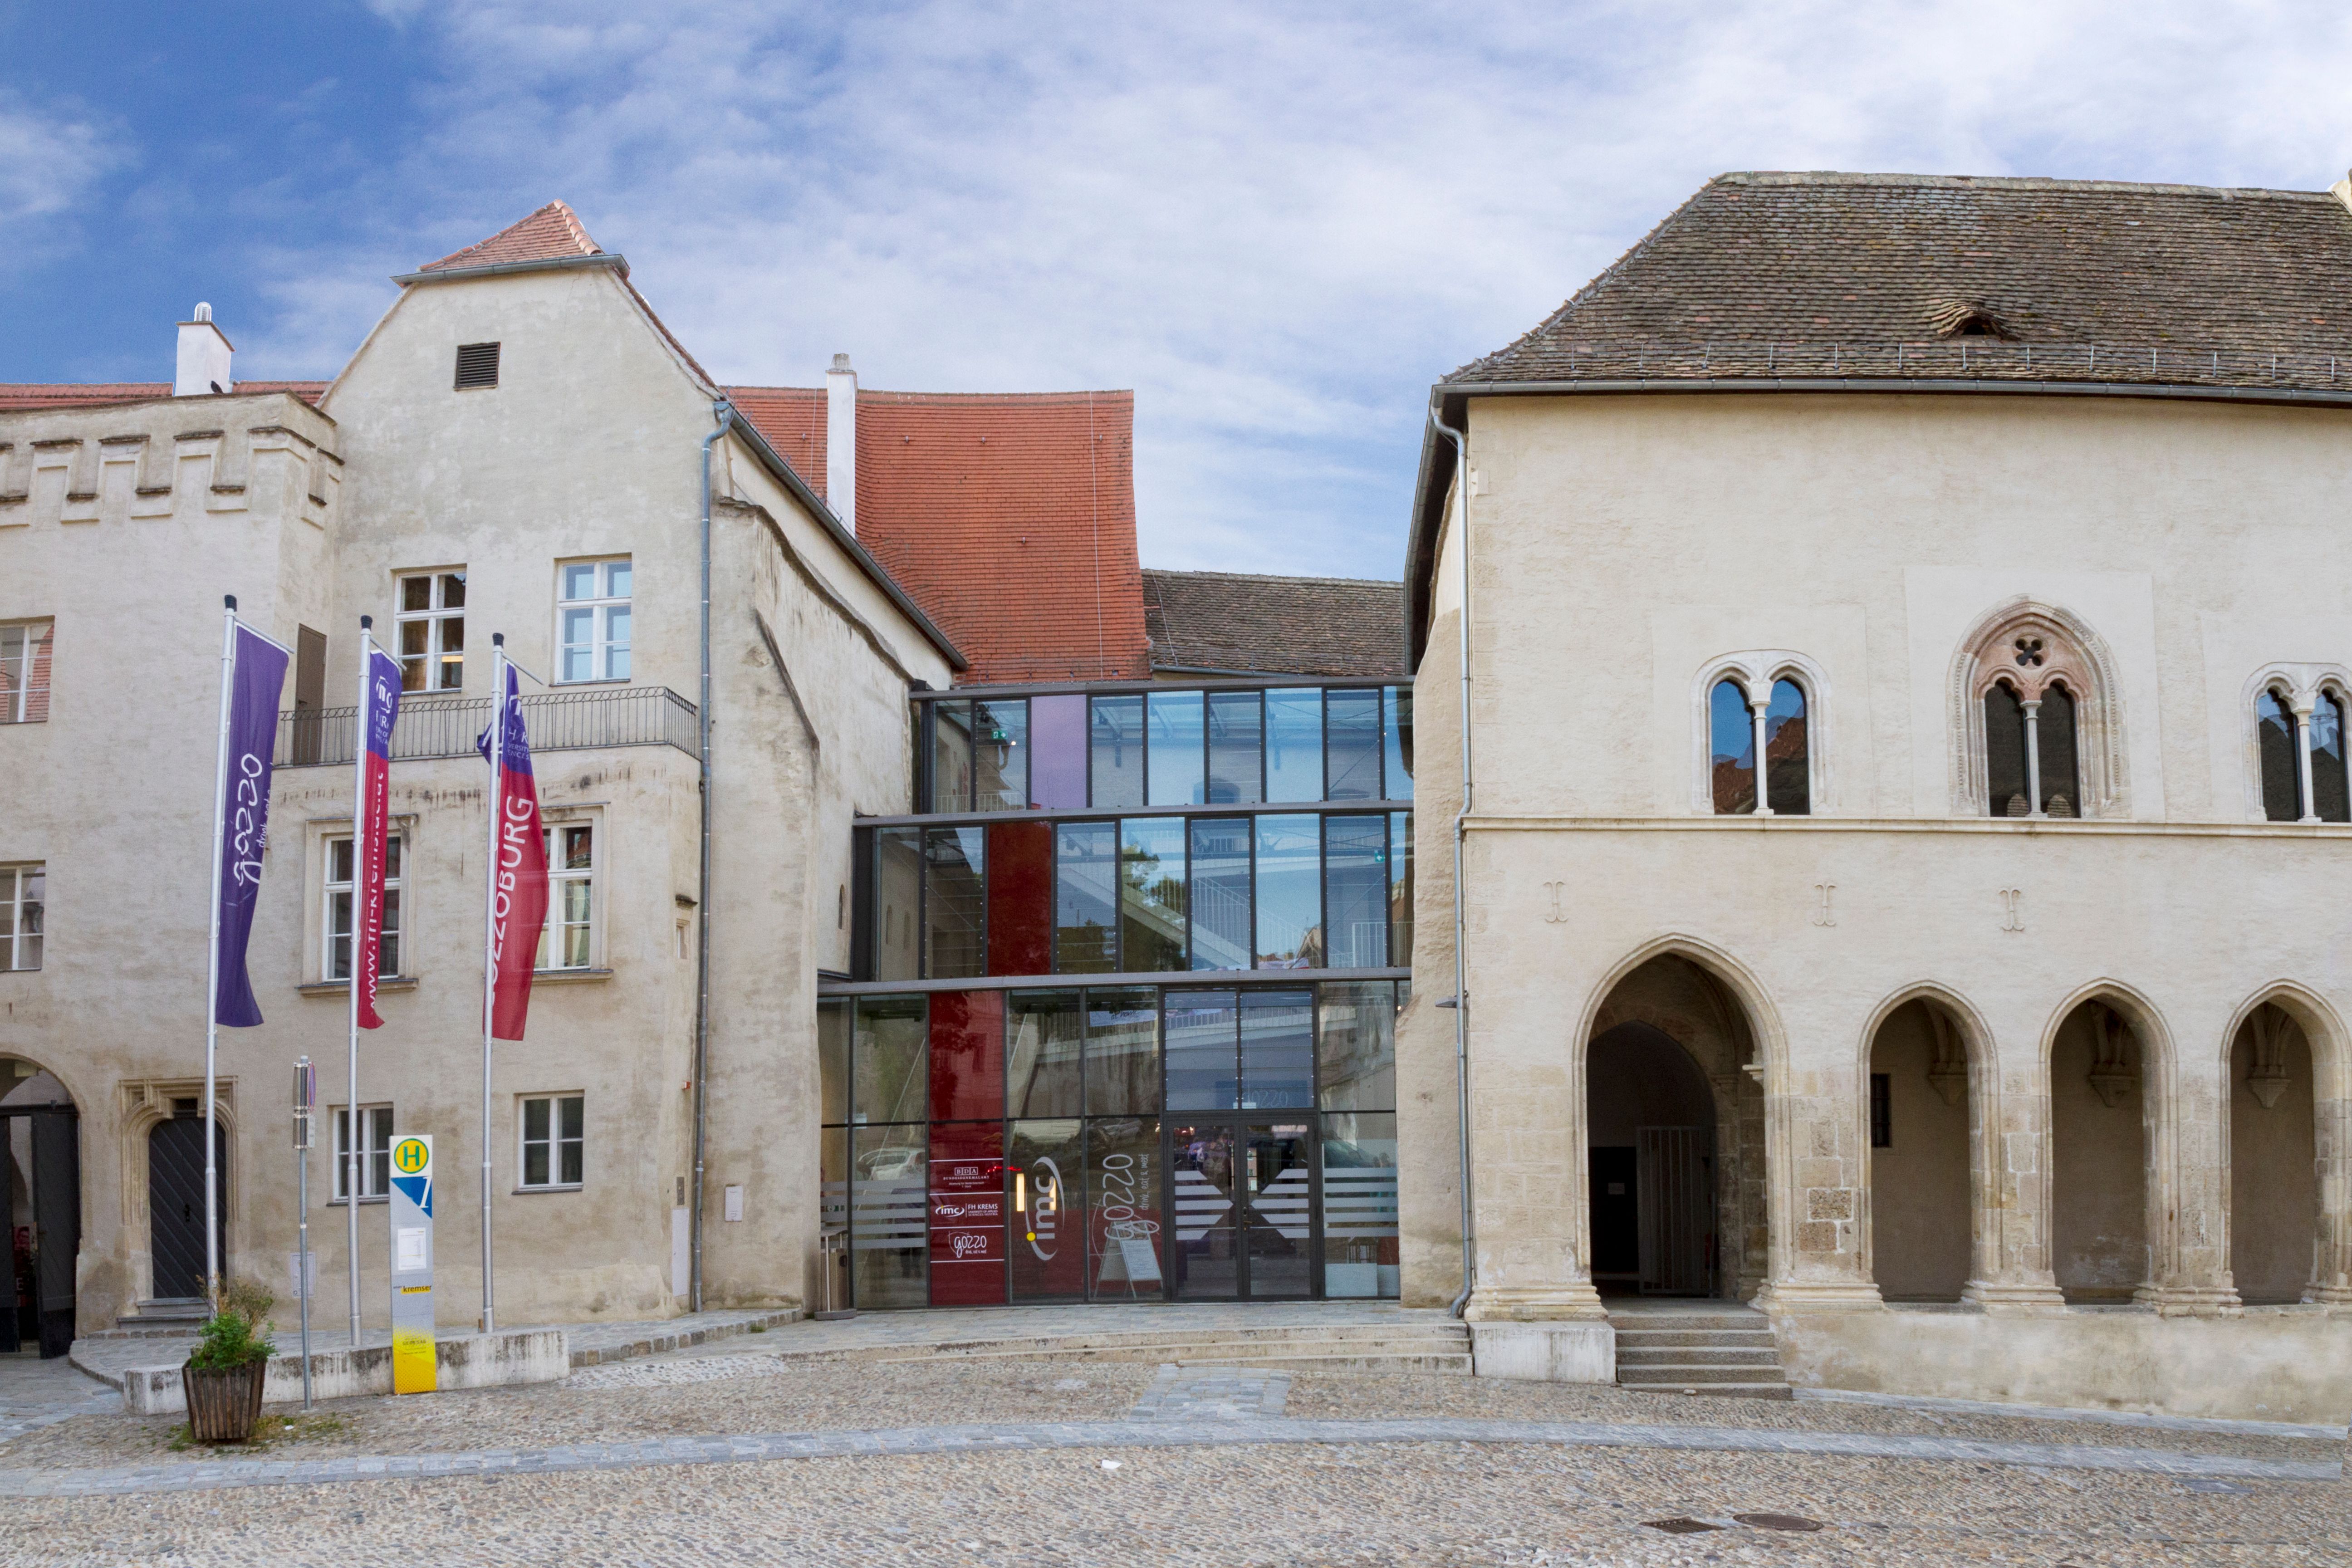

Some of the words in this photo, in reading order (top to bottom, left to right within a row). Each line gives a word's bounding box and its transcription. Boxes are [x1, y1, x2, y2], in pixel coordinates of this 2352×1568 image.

[234, 753, 263, 887] gozzo
[492, 795, 534, 1007] OZZOBURG
[403, 1145, 420, 1167] H
[419, 1176, 432, 1208] 1
[1102, 1154, 1160, 1240] gozzo
[1138, 1178, 1149, 1189] eat
[941, 1205, 960, 1215] imc
[1028, 1176, 1055, 1241] imc
[954, 1235, 987, 1258] gozzo
